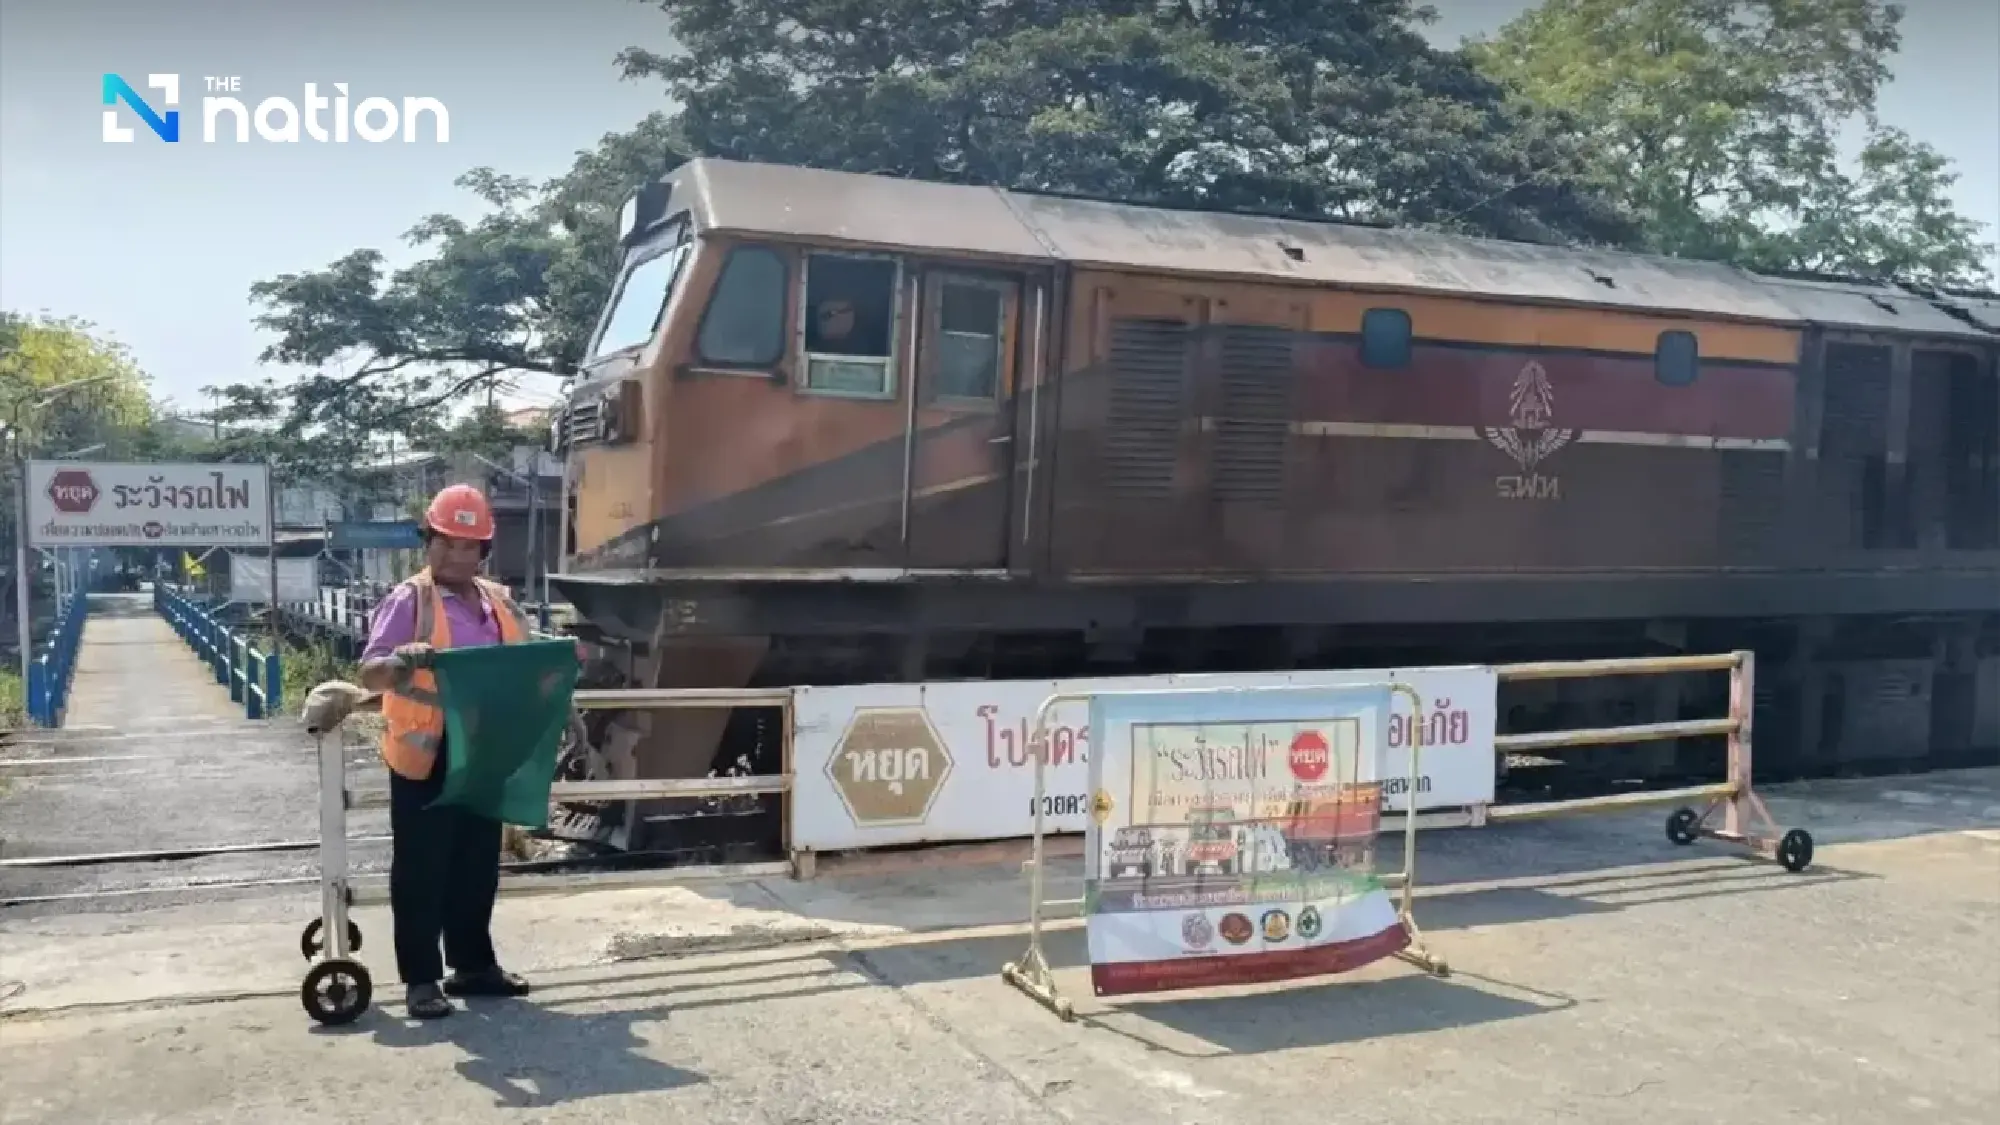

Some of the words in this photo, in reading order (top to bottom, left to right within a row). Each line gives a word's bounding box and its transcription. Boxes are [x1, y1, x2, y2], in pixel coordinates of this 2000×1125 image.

[112, 471, 251, 510] ระวังรถไฟ
[844, 747, 931, 797] หยุด
[1291, 748, 1326, 773] หยุด
